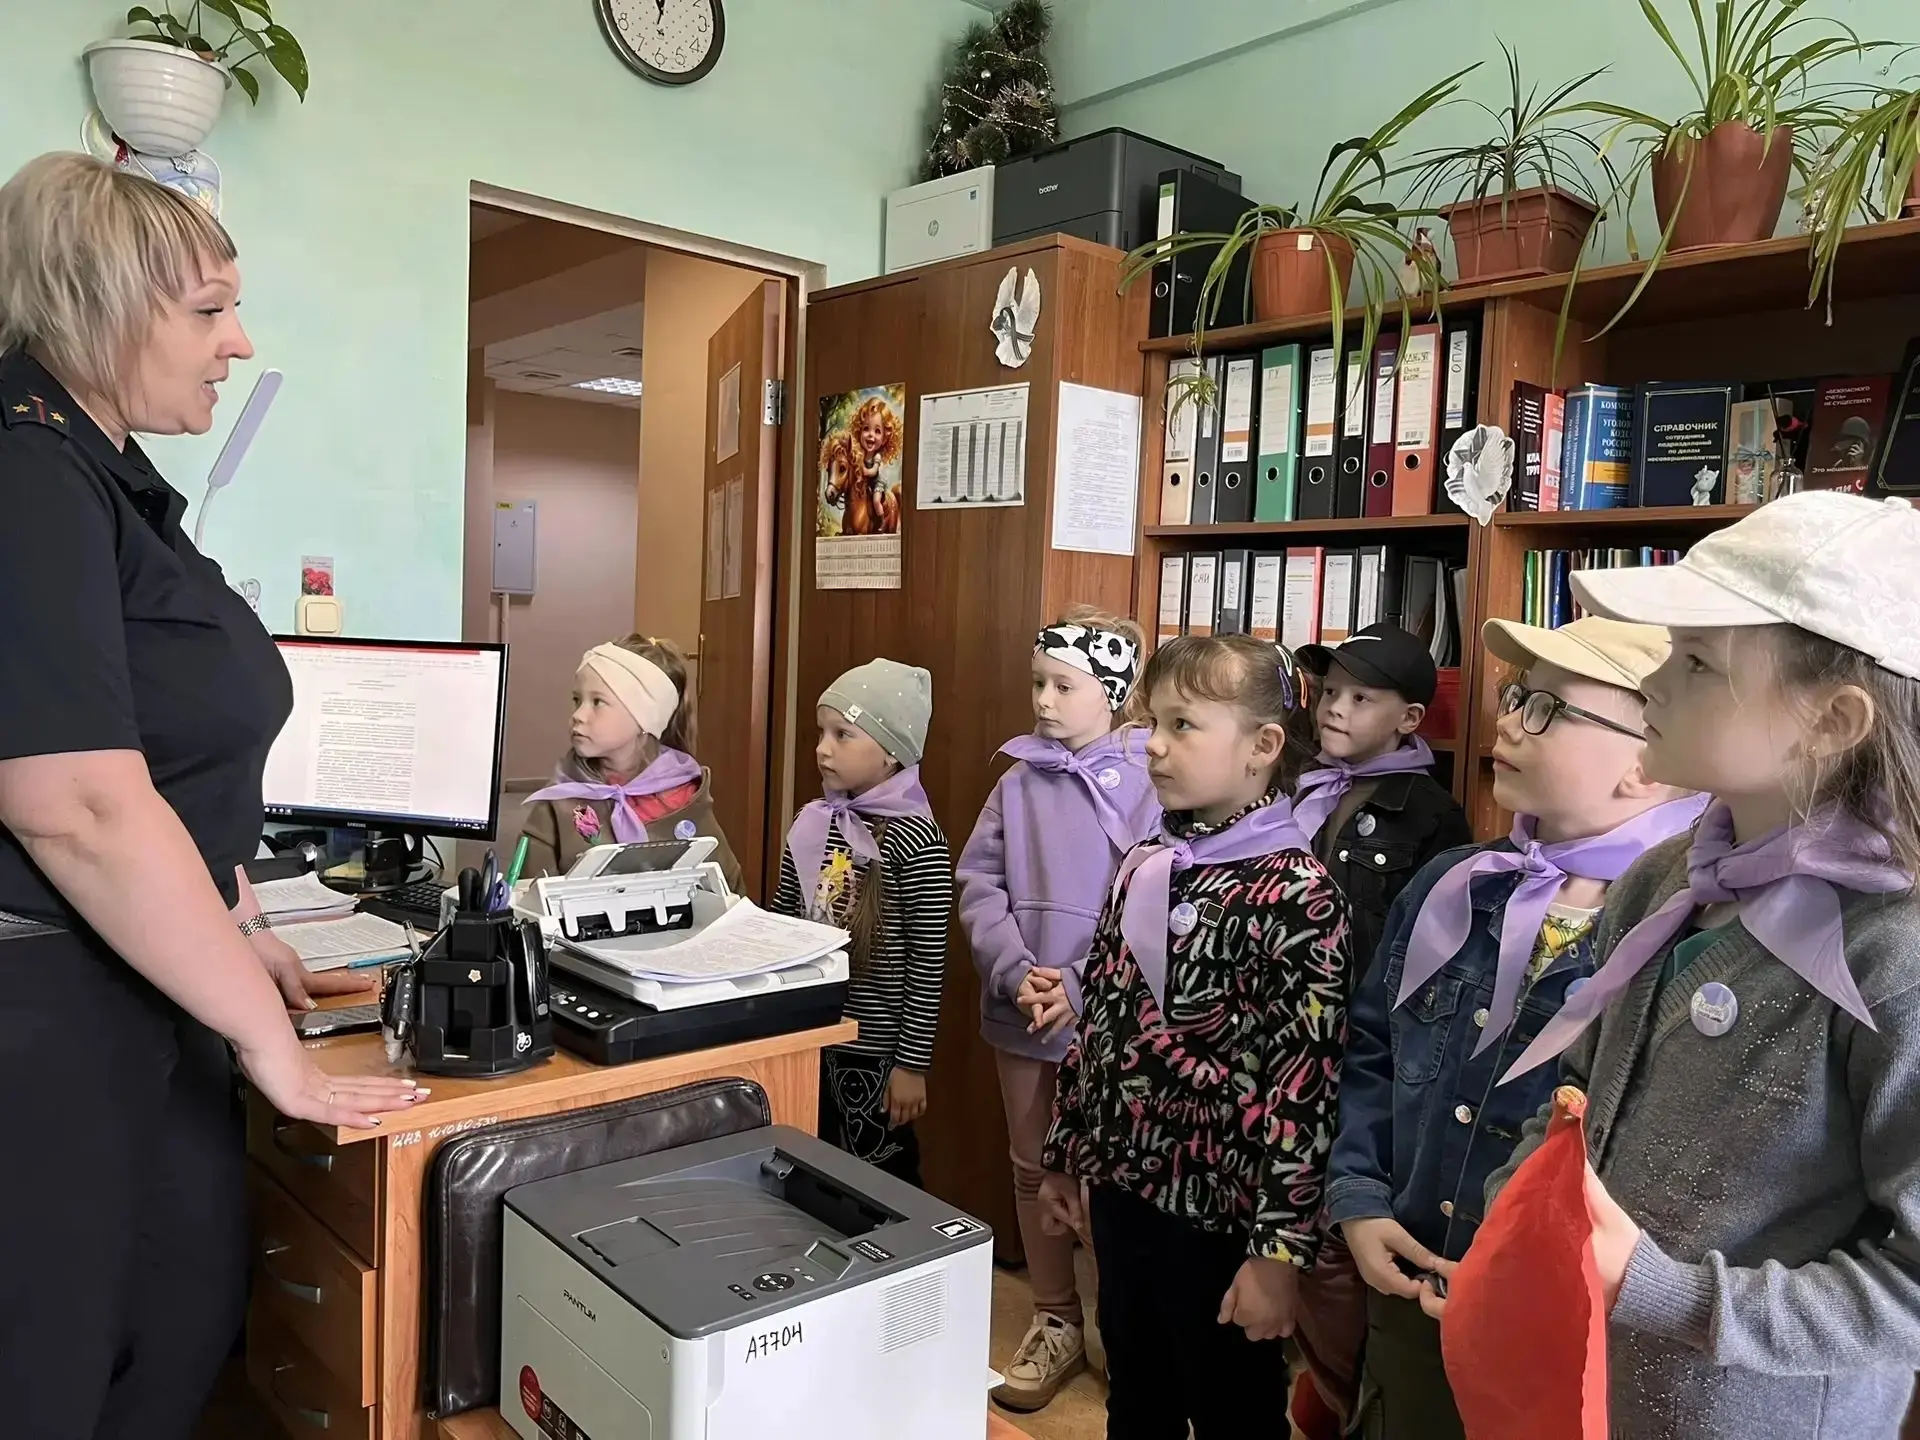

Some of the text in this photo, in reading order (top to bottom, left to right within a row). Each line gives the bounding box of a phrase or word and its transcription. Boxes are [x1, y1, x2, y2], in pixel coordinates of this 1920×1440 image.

[618, 12, 629, 31] 8
[697, 14, 708, 33] 3
[636, 34, 645, 52] 7
[689, 38, 700, 54] 4
[654, 47, 666, 66] 6
[674, 46, 686, 66] 5
[1038, 183, 1059, 195] brother
[1653, 422, 1718, 433] СПРАВОЧНИК
[1664, 433, 1705, 441] сотрудника
[562, 1289, 598, 1323] PANTUM
[745, 1321, 803, 1364] A7704
